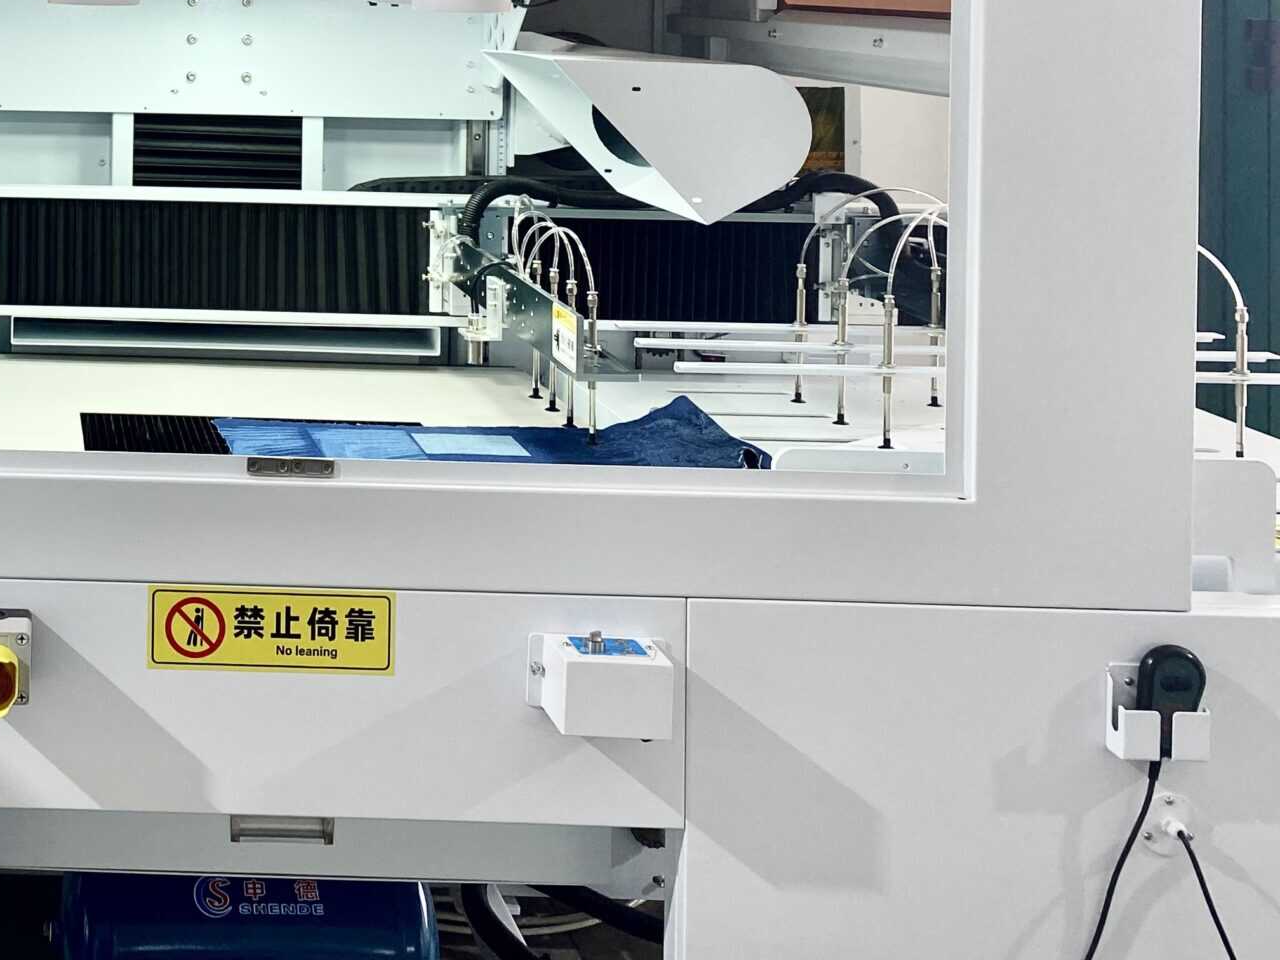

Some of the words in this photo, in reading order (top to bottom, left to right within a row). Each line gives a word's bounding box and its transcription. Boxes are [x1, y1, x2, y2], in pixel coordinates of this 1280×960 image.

[233, 604, 376, 642] 禁止倚靠
[275, 645, 293, 657] No
[295, 645, 338, 660] leaning
[238, 902, 326, 916] SHENDE
